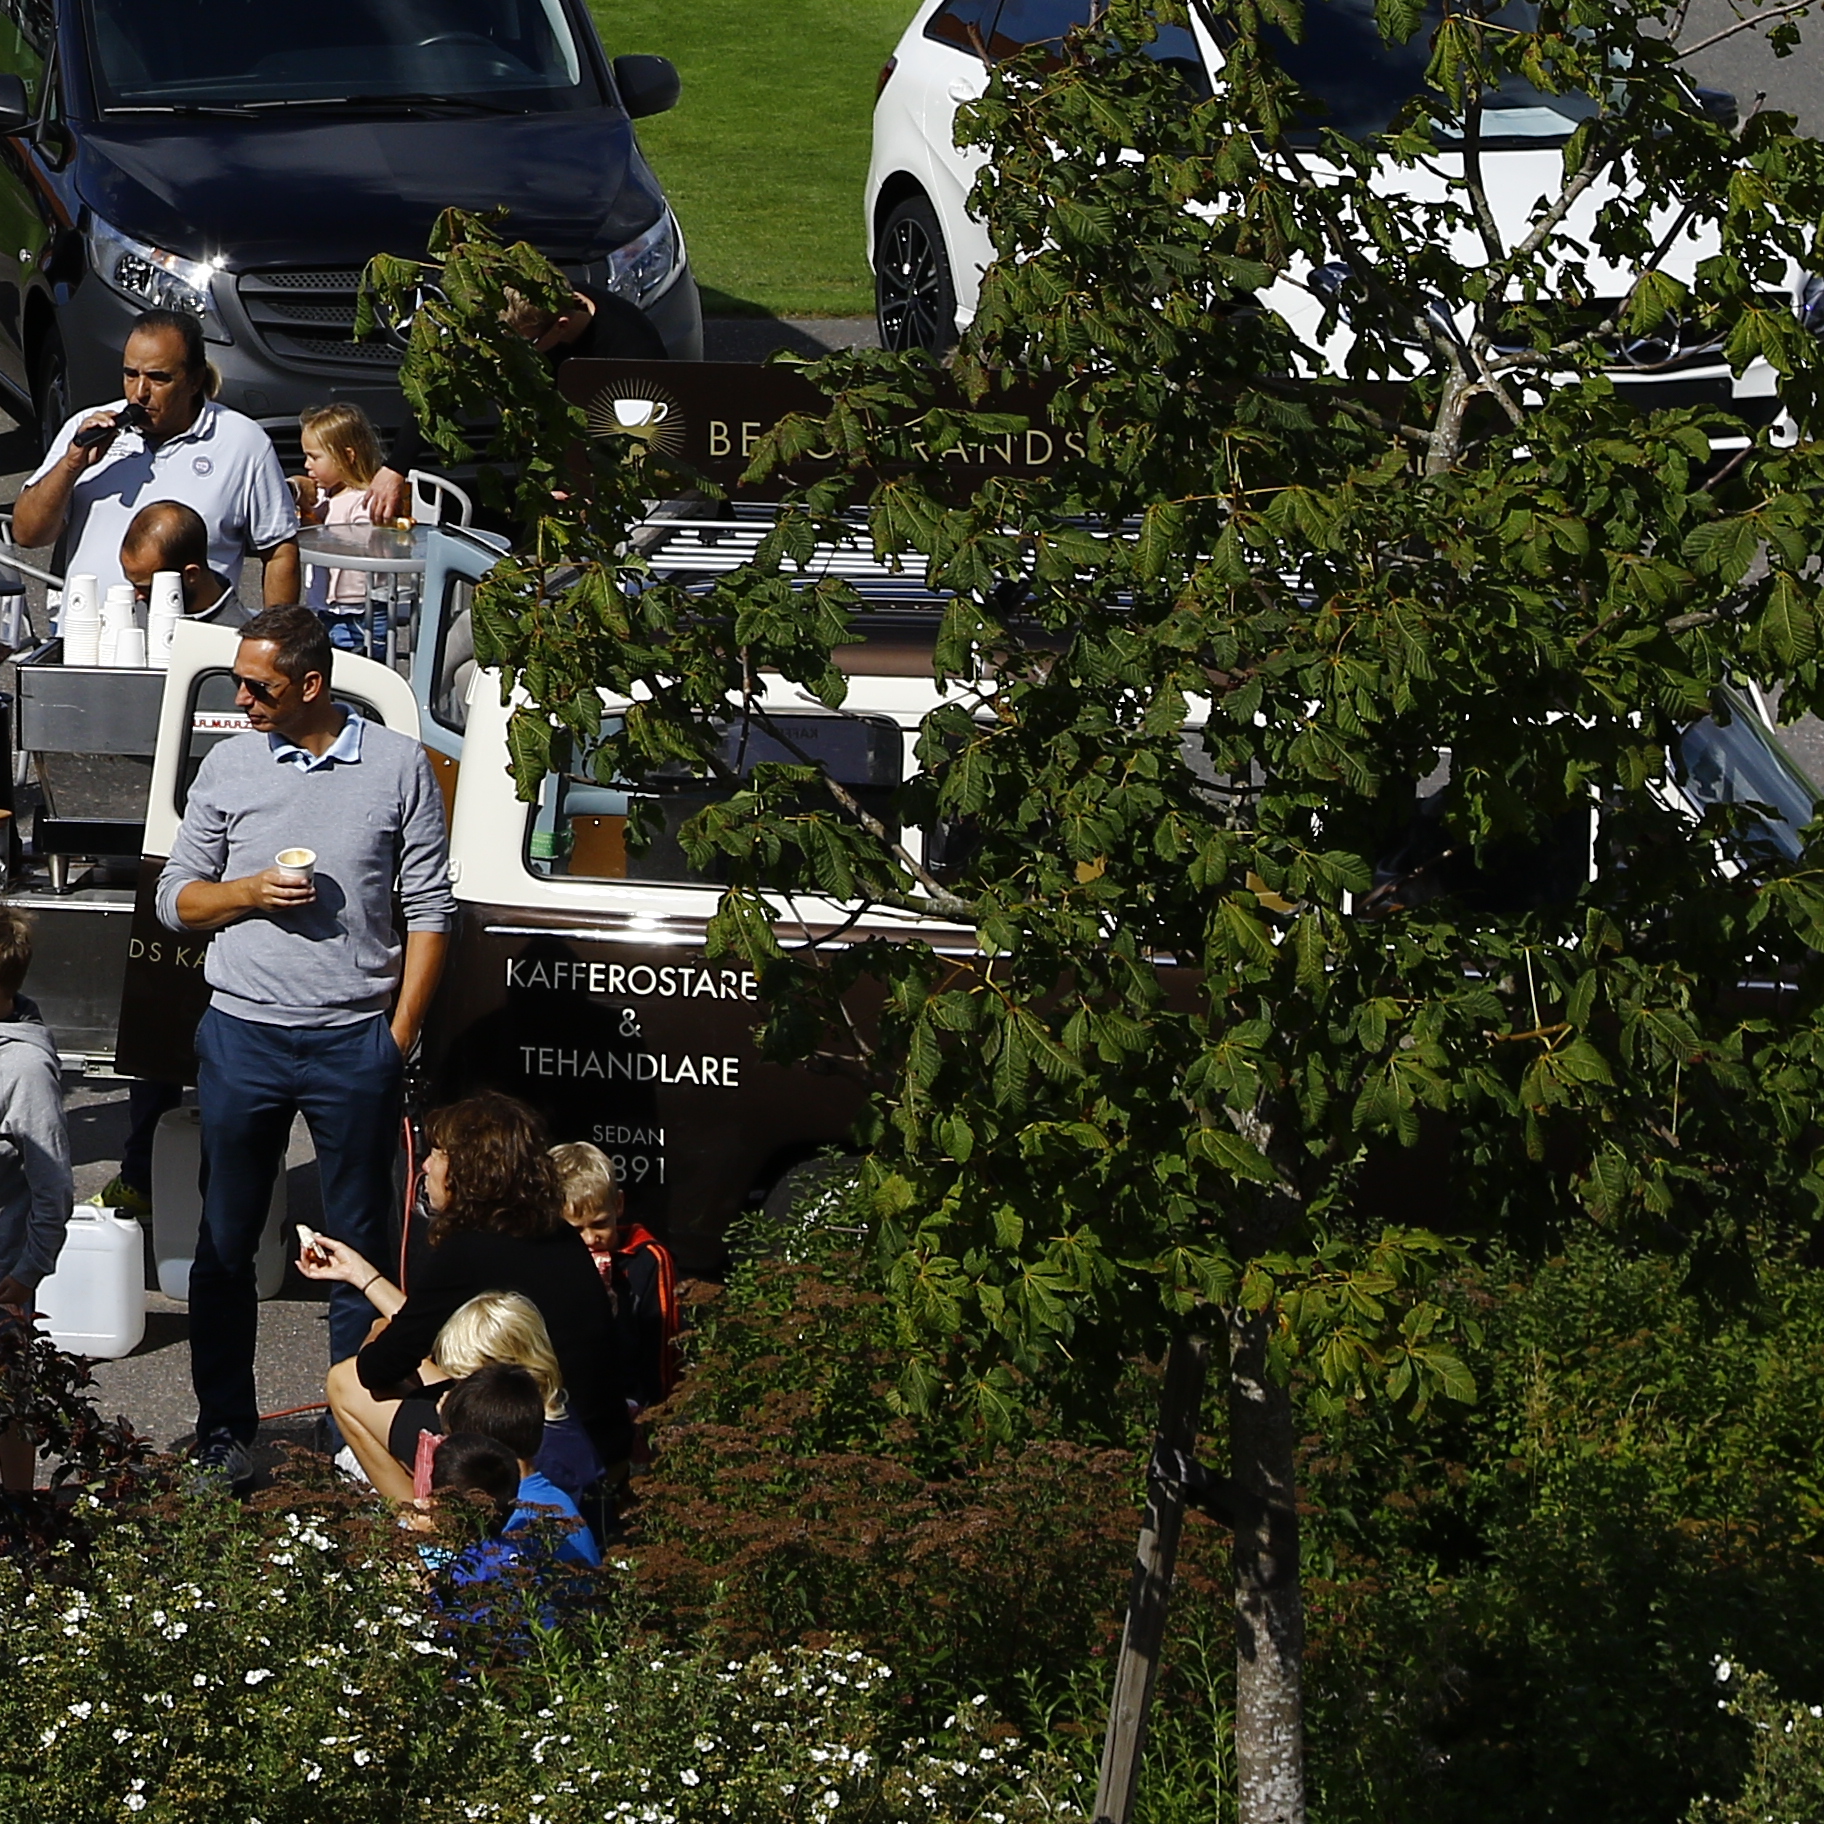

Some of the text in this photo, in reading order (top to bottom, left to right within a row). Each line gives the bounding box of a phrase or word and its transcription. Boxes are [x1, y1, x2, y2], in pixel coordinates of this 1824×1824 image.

[506, 958, 758, 1001] KAFFEROSTARE
[619, 1008, 642, 1038] &
[519, 1046, 740, 1087] TEHANDLARE
[592, 1124, 665, 1147] SEDAN
[611, 1153, 666, 1185] 891
